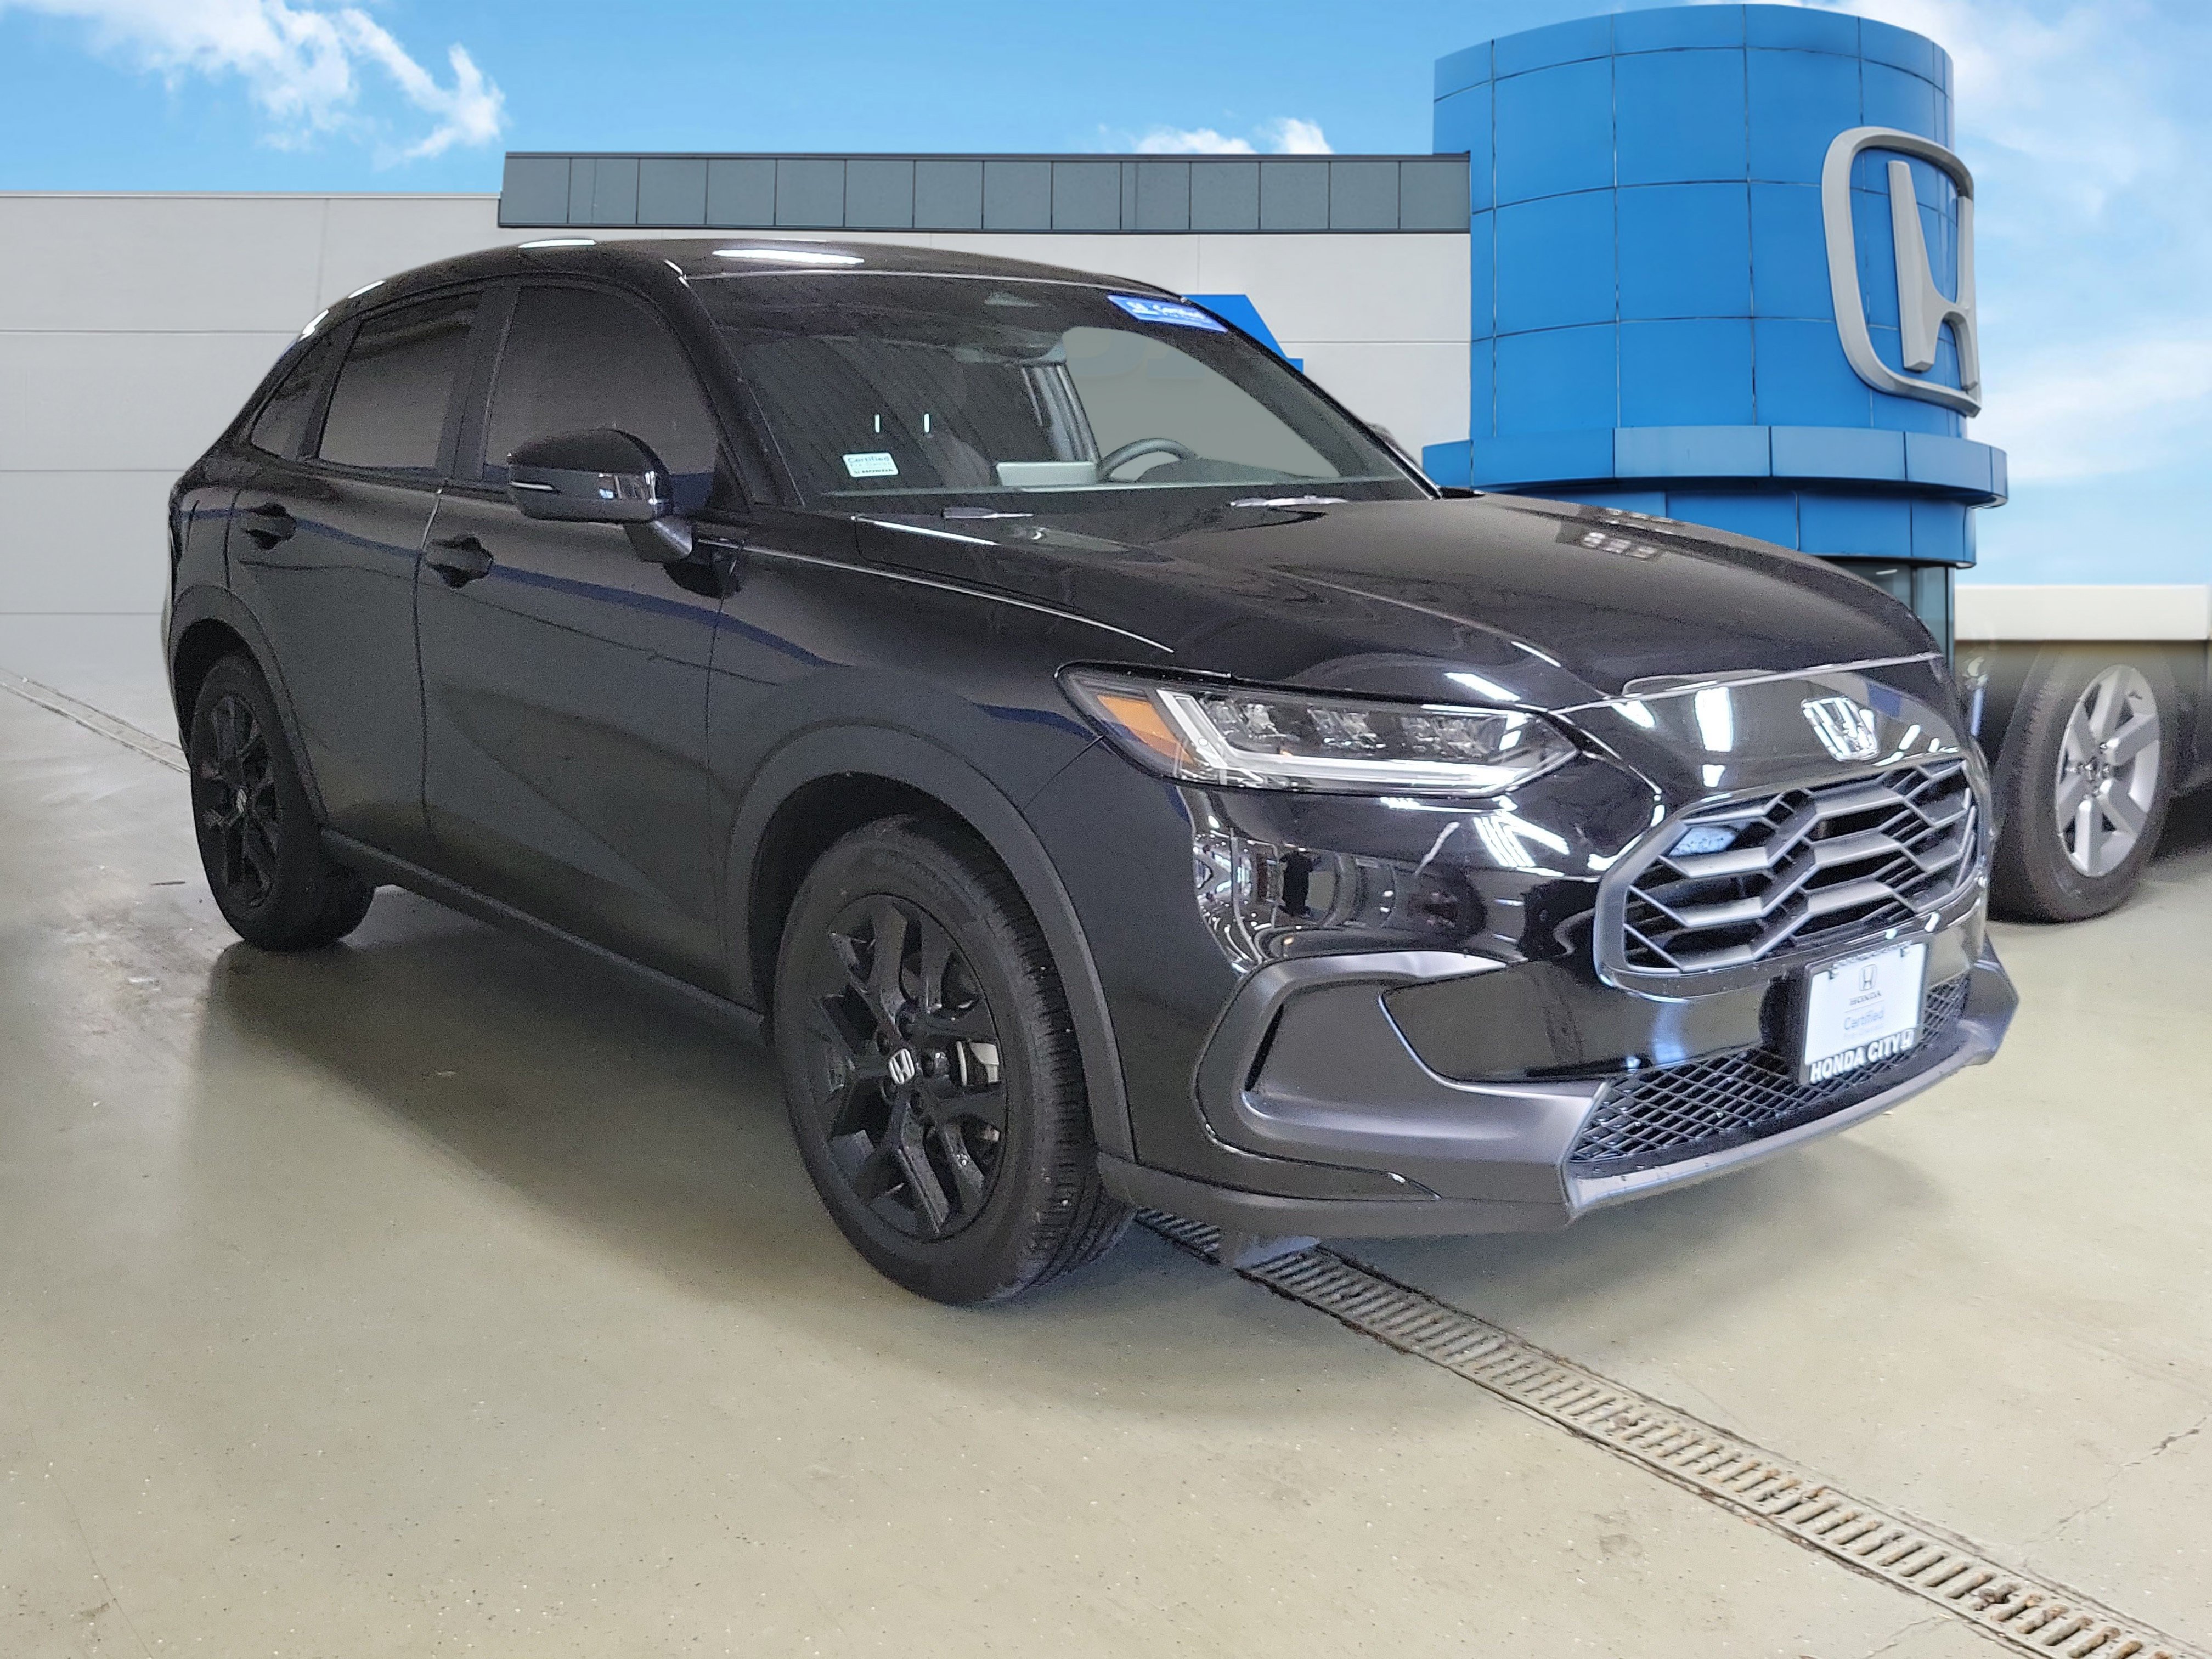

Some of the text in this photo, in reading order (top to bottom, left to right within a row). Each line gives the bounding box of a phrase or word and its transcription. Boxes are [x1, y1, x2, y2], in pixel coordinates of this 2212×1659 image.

[1850, 991, 1882, 1005] HONDA
[1844, 1007, 1884, 1030] Certified
[1810, 1033, 1901, 1084] HONDA CITY
